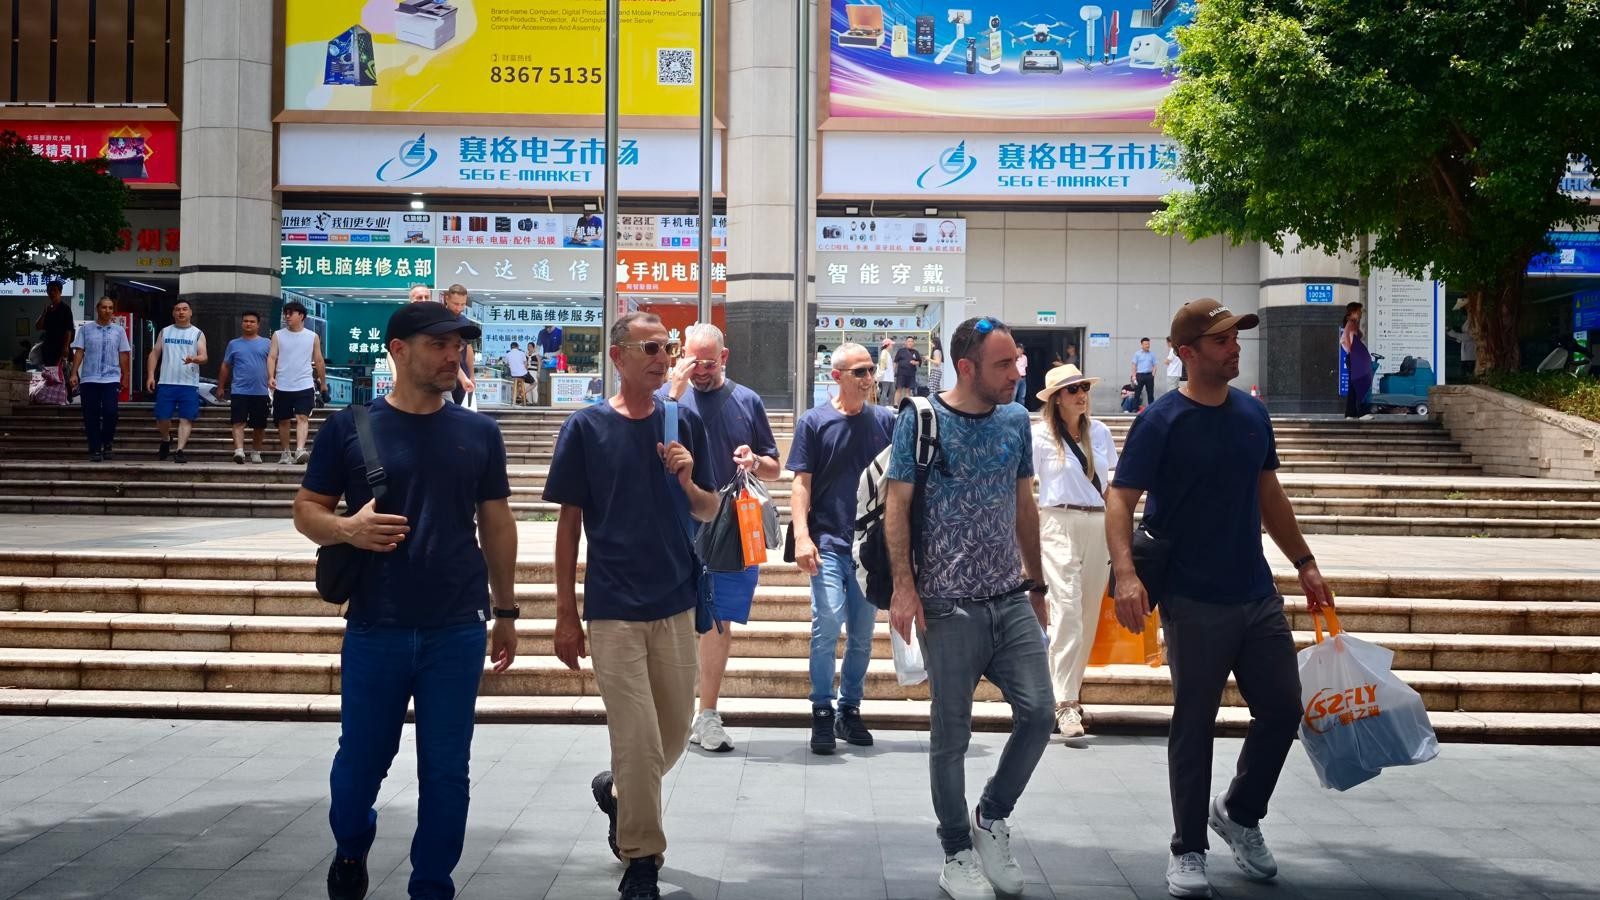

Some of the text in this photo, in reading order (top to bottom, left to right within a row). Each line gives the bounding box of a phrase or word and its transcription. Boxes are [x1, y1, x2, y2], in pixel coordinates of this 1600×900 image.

[490, 66, 602, 83] 8367 5135
[32, 144, 87, 158] 影精灵11
[459, 136, 639, 165] 赛格电子市场
[998, 143, 1176, 171] 赛格电子市场
[459, 169, 593, 182] SEG E-MARKET
[998, 176, 1130, 187] SEG E-MARKET
[828, 262, 943, 285] 智能穿戴
[349, 326, 381, 340] 专业
